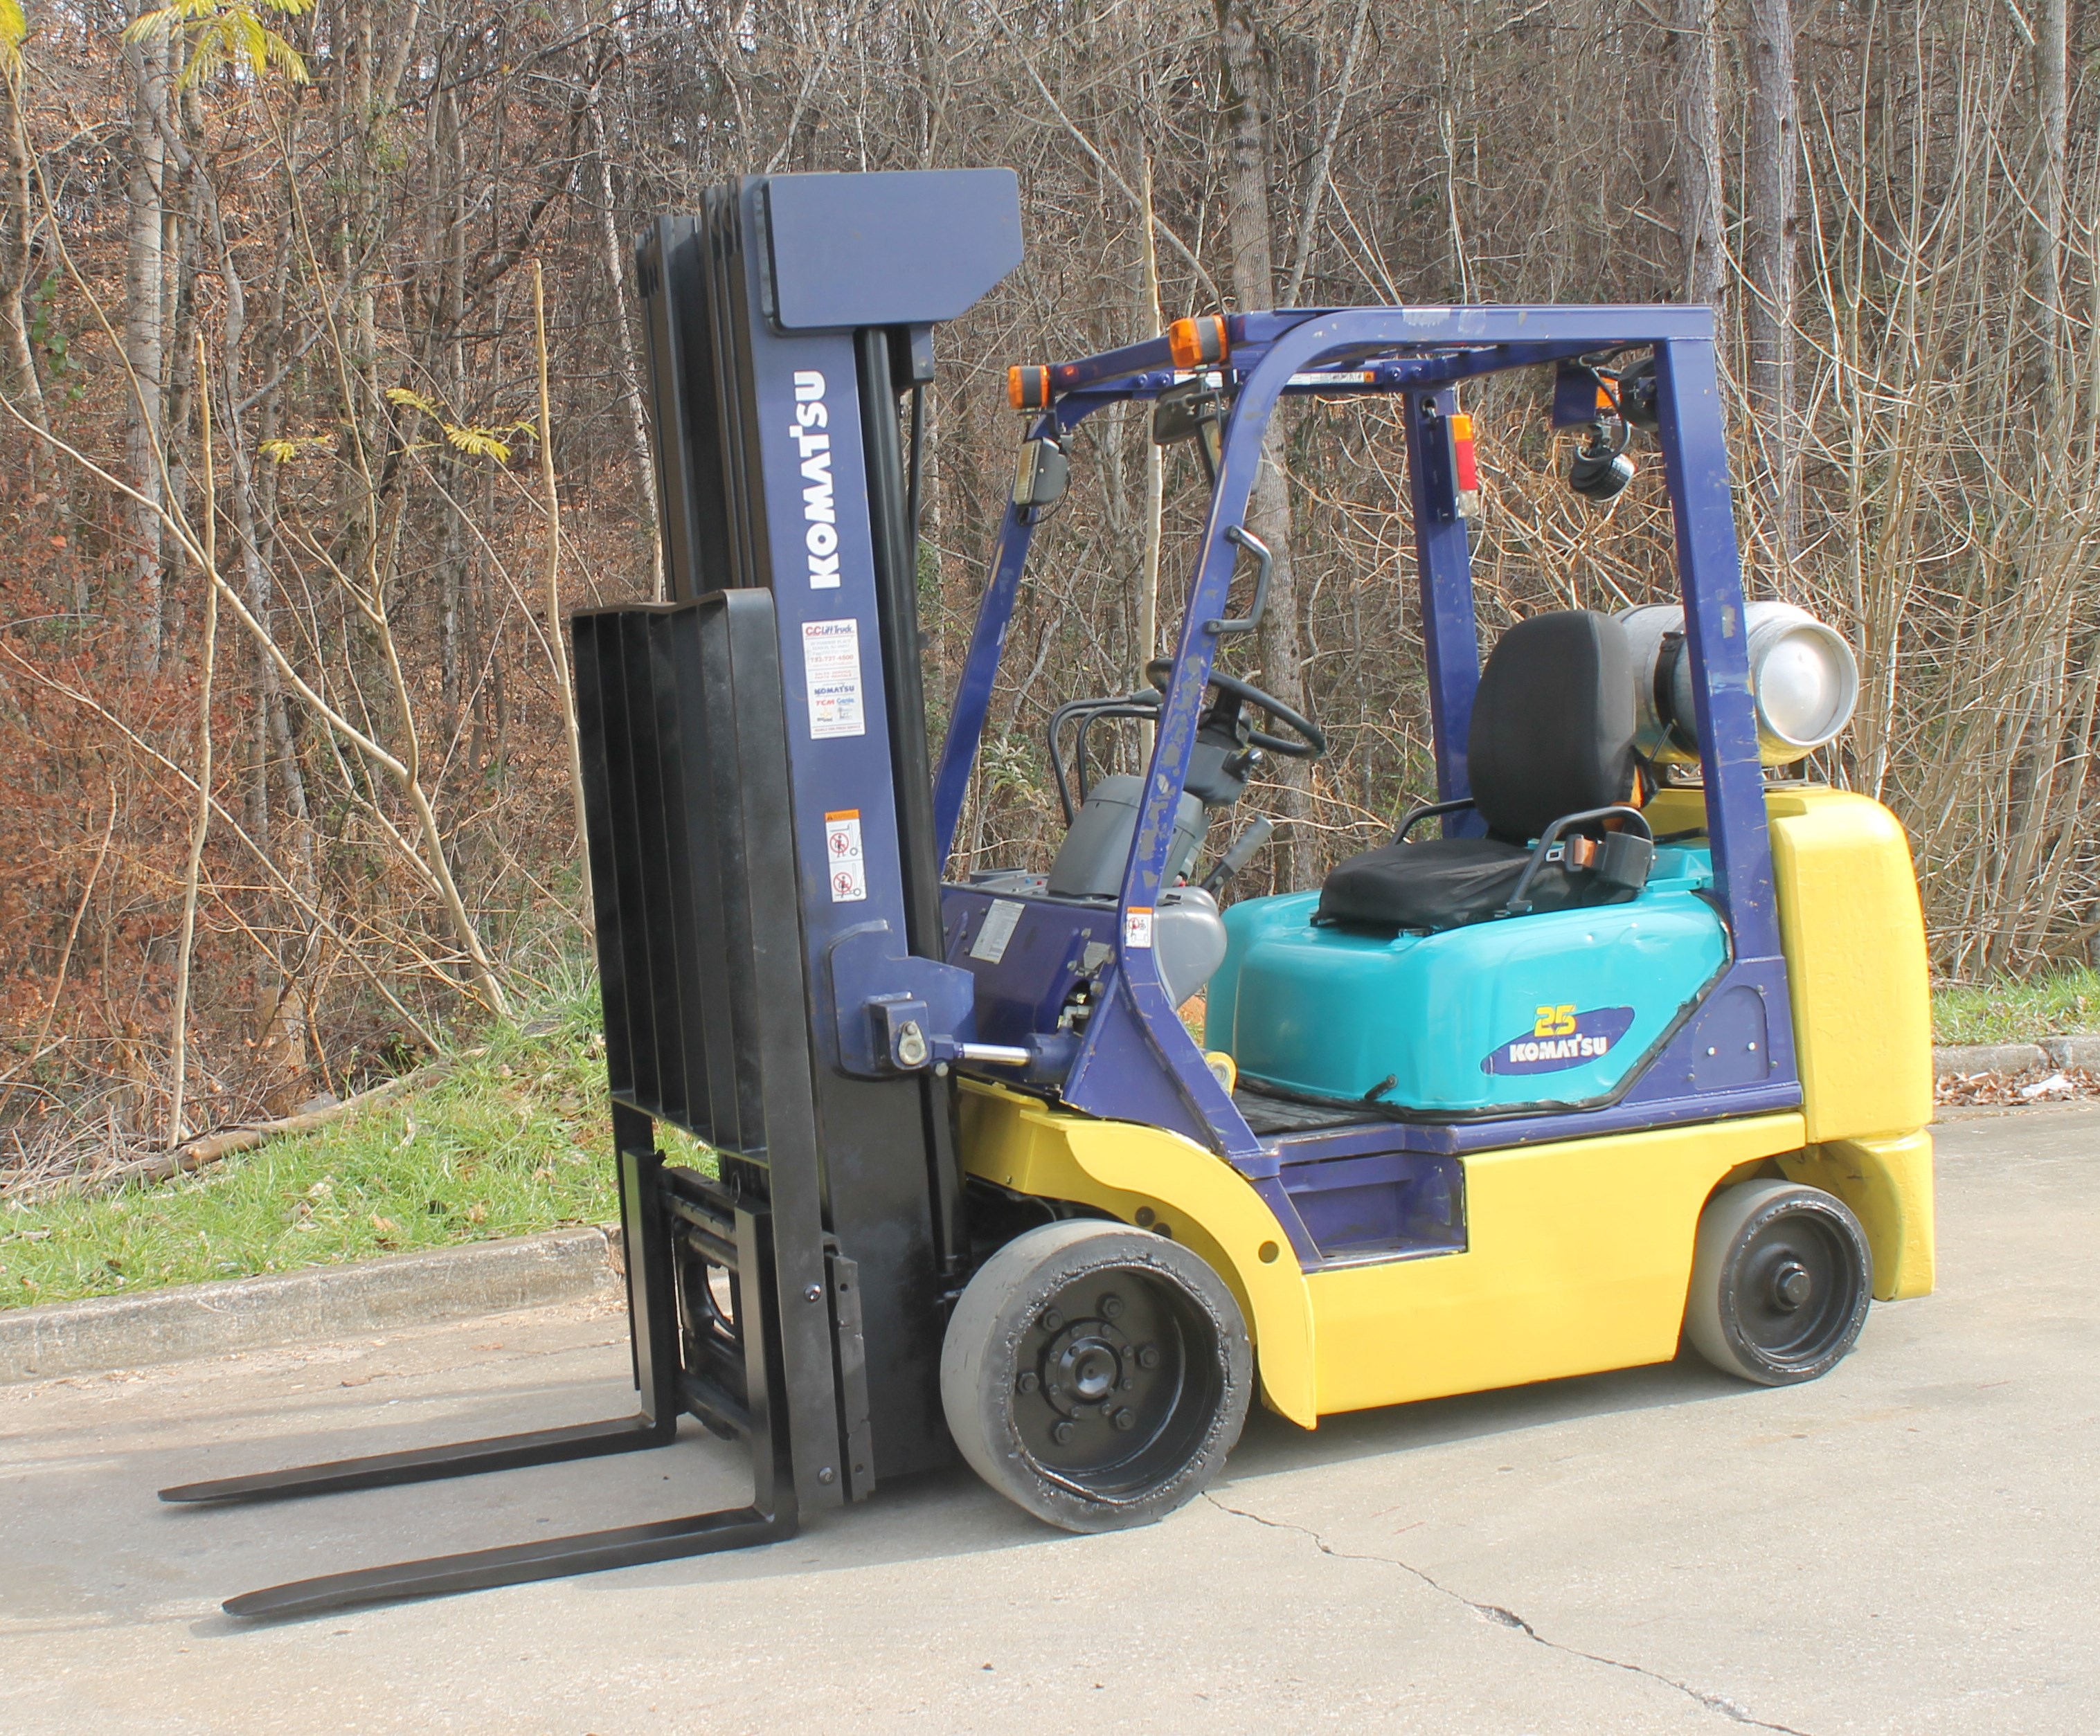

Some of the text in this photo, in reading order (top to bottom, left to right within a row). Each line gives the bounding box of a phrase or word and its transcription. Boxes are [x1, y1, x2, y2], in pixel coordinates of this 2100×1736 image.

[789, 370, 841, 590] KOMATSU
[814, 685, 854, 694] KOMATSU
[1534, 1004, 1577, 1038] 25
[1509, 1033, 1608, 1063] KOMATSU
